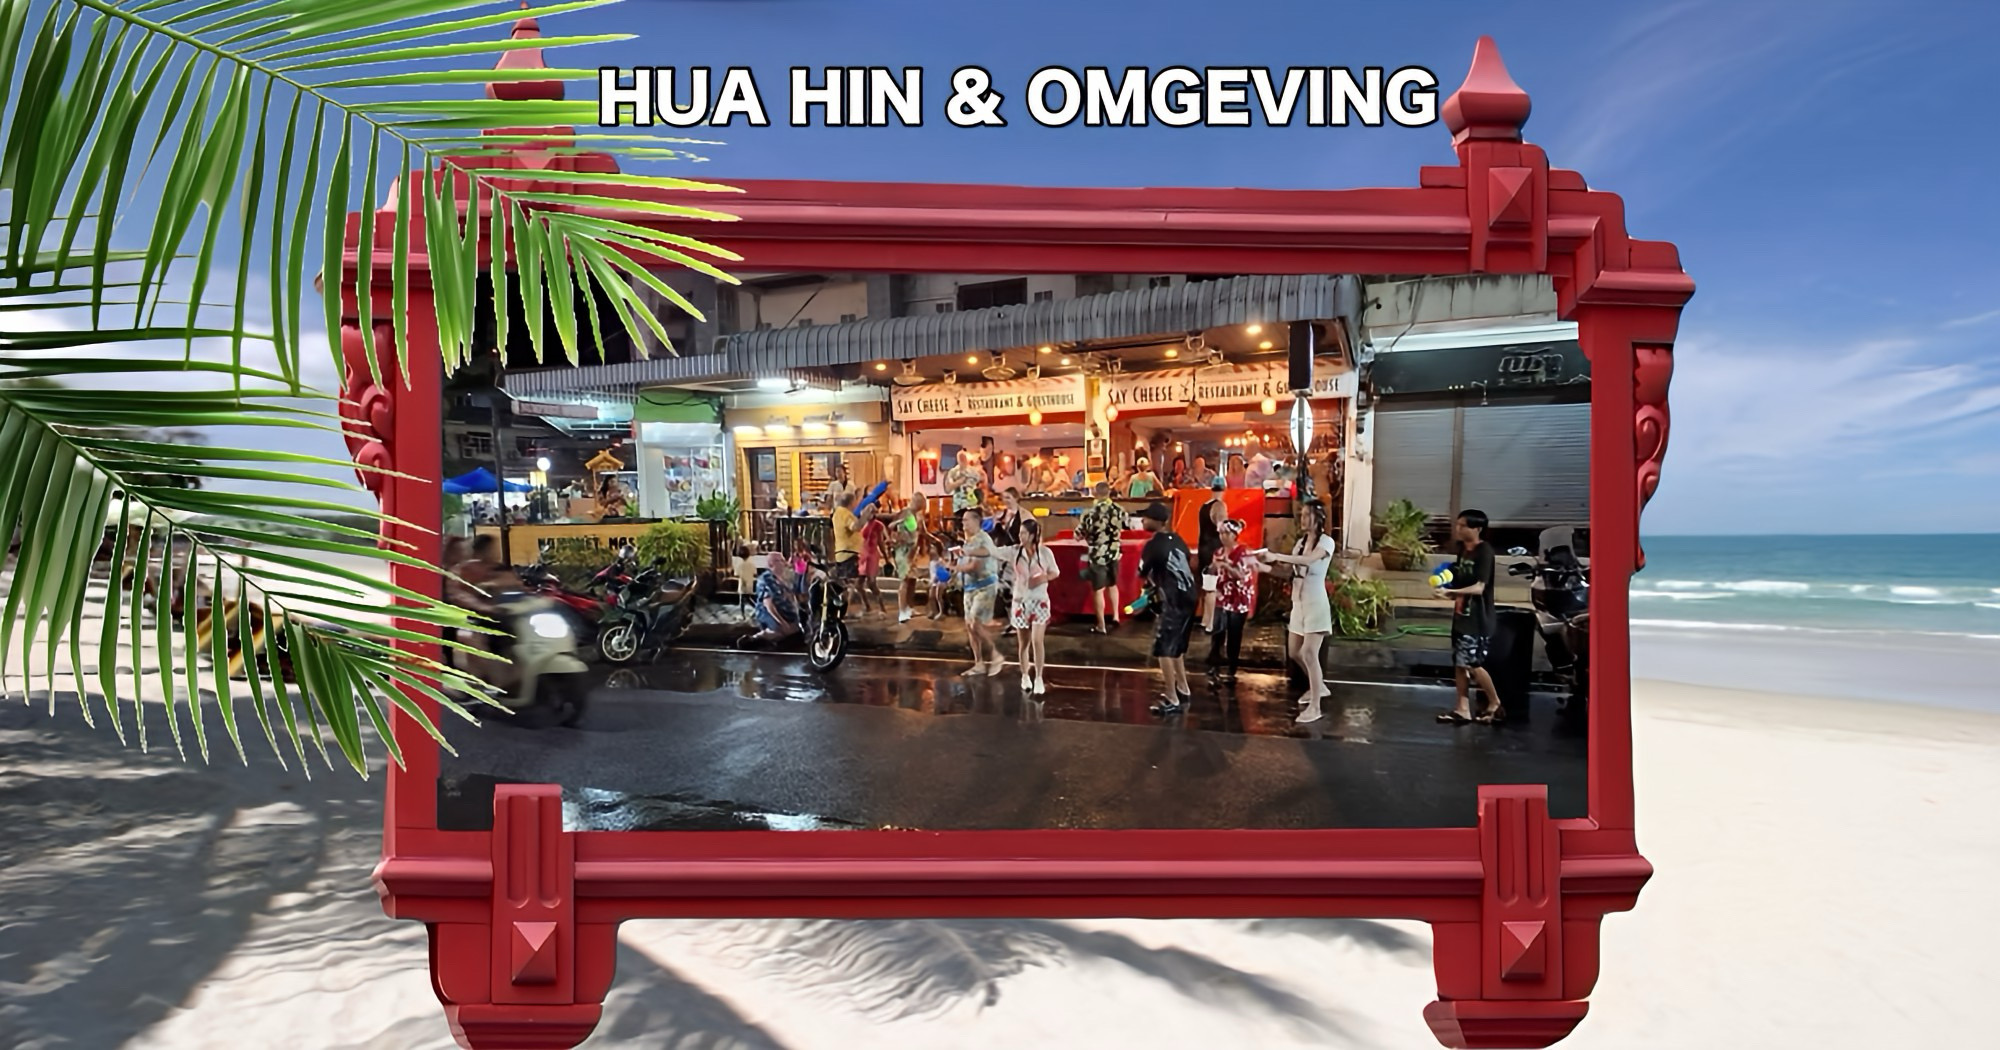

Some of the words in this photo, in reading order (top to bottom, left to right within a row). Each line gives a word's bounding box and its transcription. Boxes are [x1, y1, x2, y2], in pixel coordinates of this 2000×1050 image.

[898, 401, 913, 414] SAY
[918, 398, 949, 413] CHEESE
[968, 397, 1014, 410] RESTAURANT
[1017, 395, 1023, 407] &
[1027, 393, 1074, 408] GUESTHOUSE
[1108, 389, 1127, 405] SAY
[1133, 385, 1173, 402] CHEESE
[1198, 383, 1257, 399] RESTAURANT
[1263, 382, 1271, 397] &
[1276, 378, 1339, 394] GUOUSE
